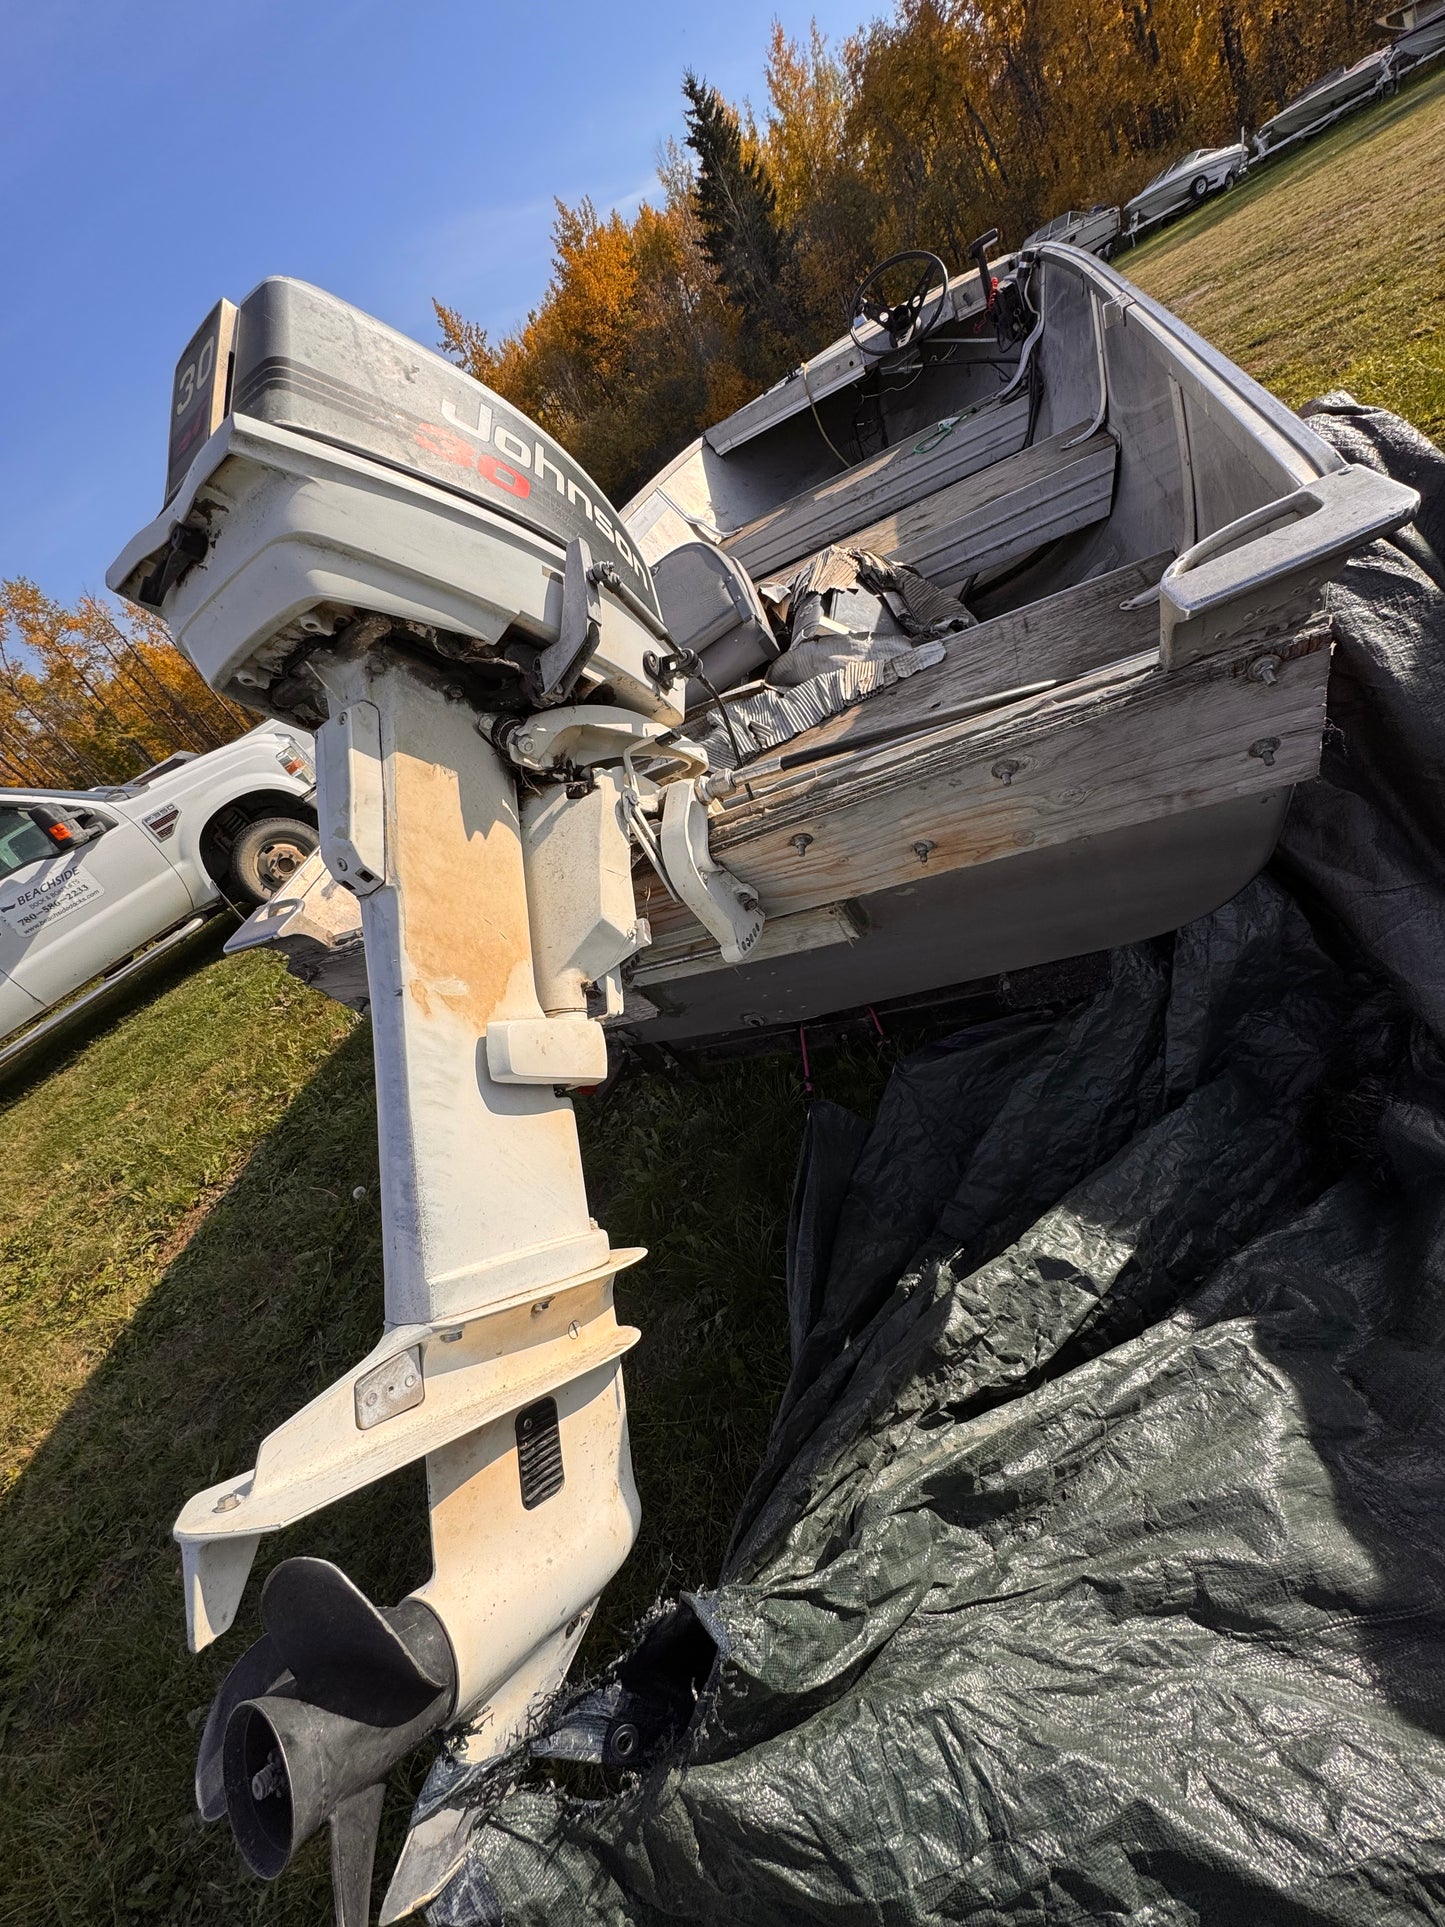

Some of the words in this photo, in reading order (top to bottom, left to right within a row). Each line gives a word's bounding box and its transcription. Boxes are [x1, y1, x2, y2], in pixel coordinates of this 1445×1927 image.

[177, 335, 215, 416] 30
[413, 421, 531, 499] 30
[441, 398, 650, 592] Johnson
[17, 866, 80, 906] BEACHSIDE
